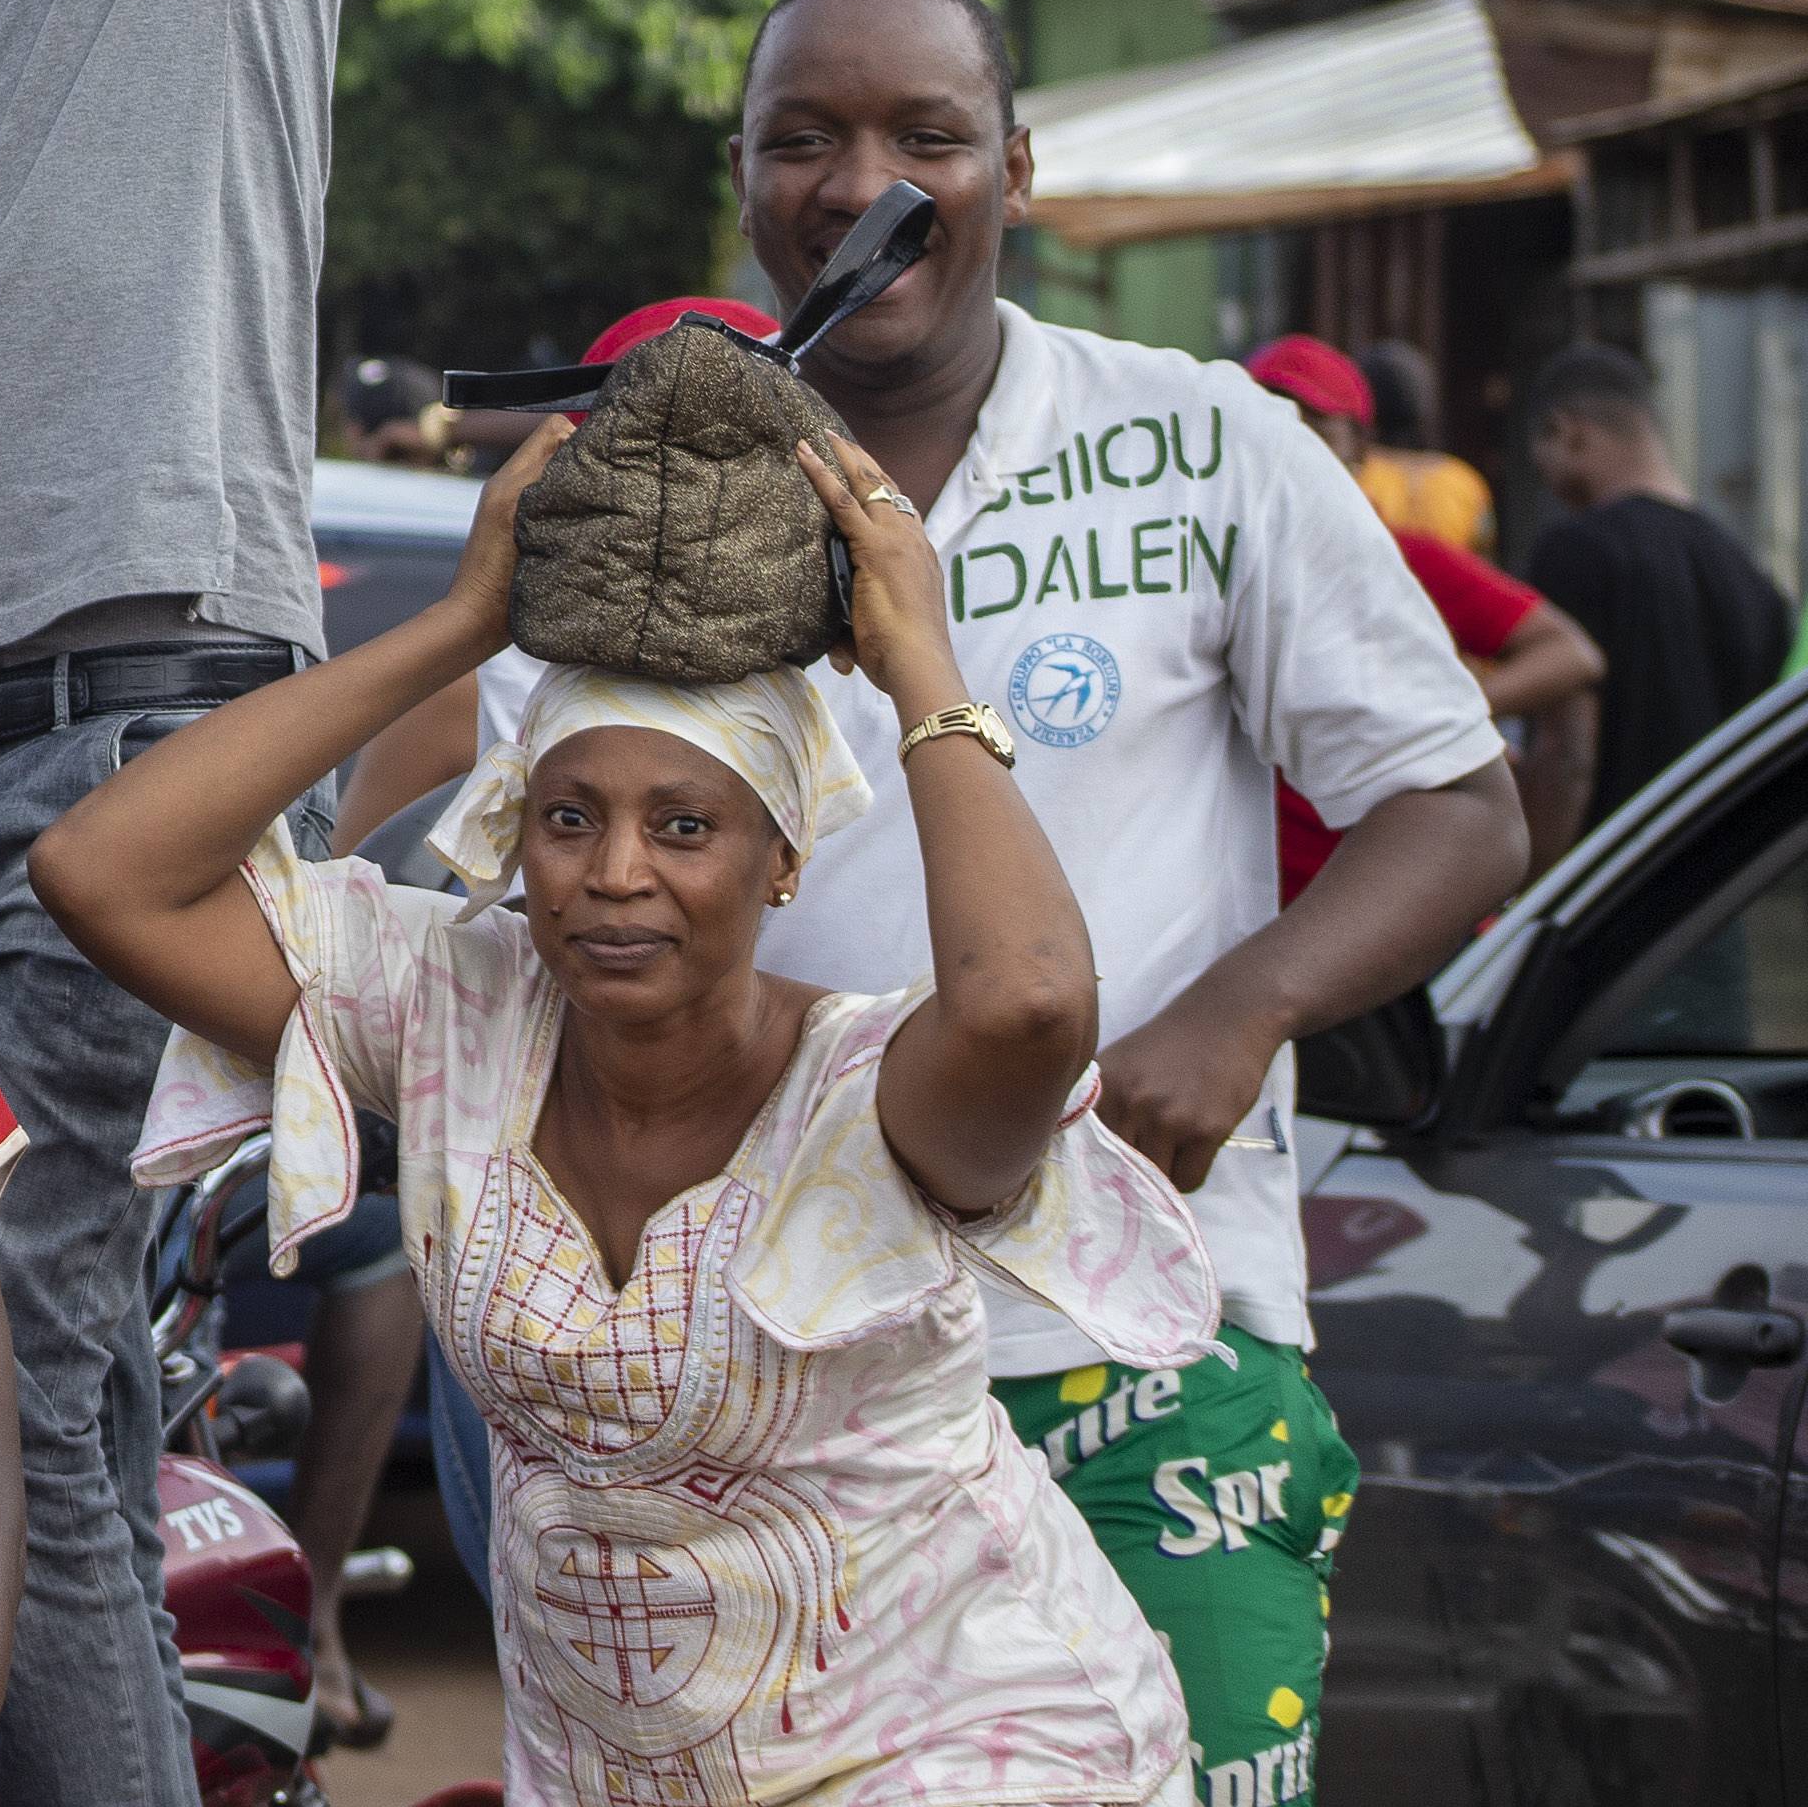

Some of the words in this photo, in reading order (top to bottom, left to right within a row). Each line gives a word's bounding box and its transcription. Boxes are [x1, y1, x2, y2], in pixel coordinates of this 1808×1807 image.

[1012, 647, 1042, 701] GRUPPO
[1032, 722, 1096, 744] VICENZA
[1035, 1368, 1182, 1481] rite
[164, 1497, 245, 1553] TVS
[1152, 1457, 1292, 1559] Spr
